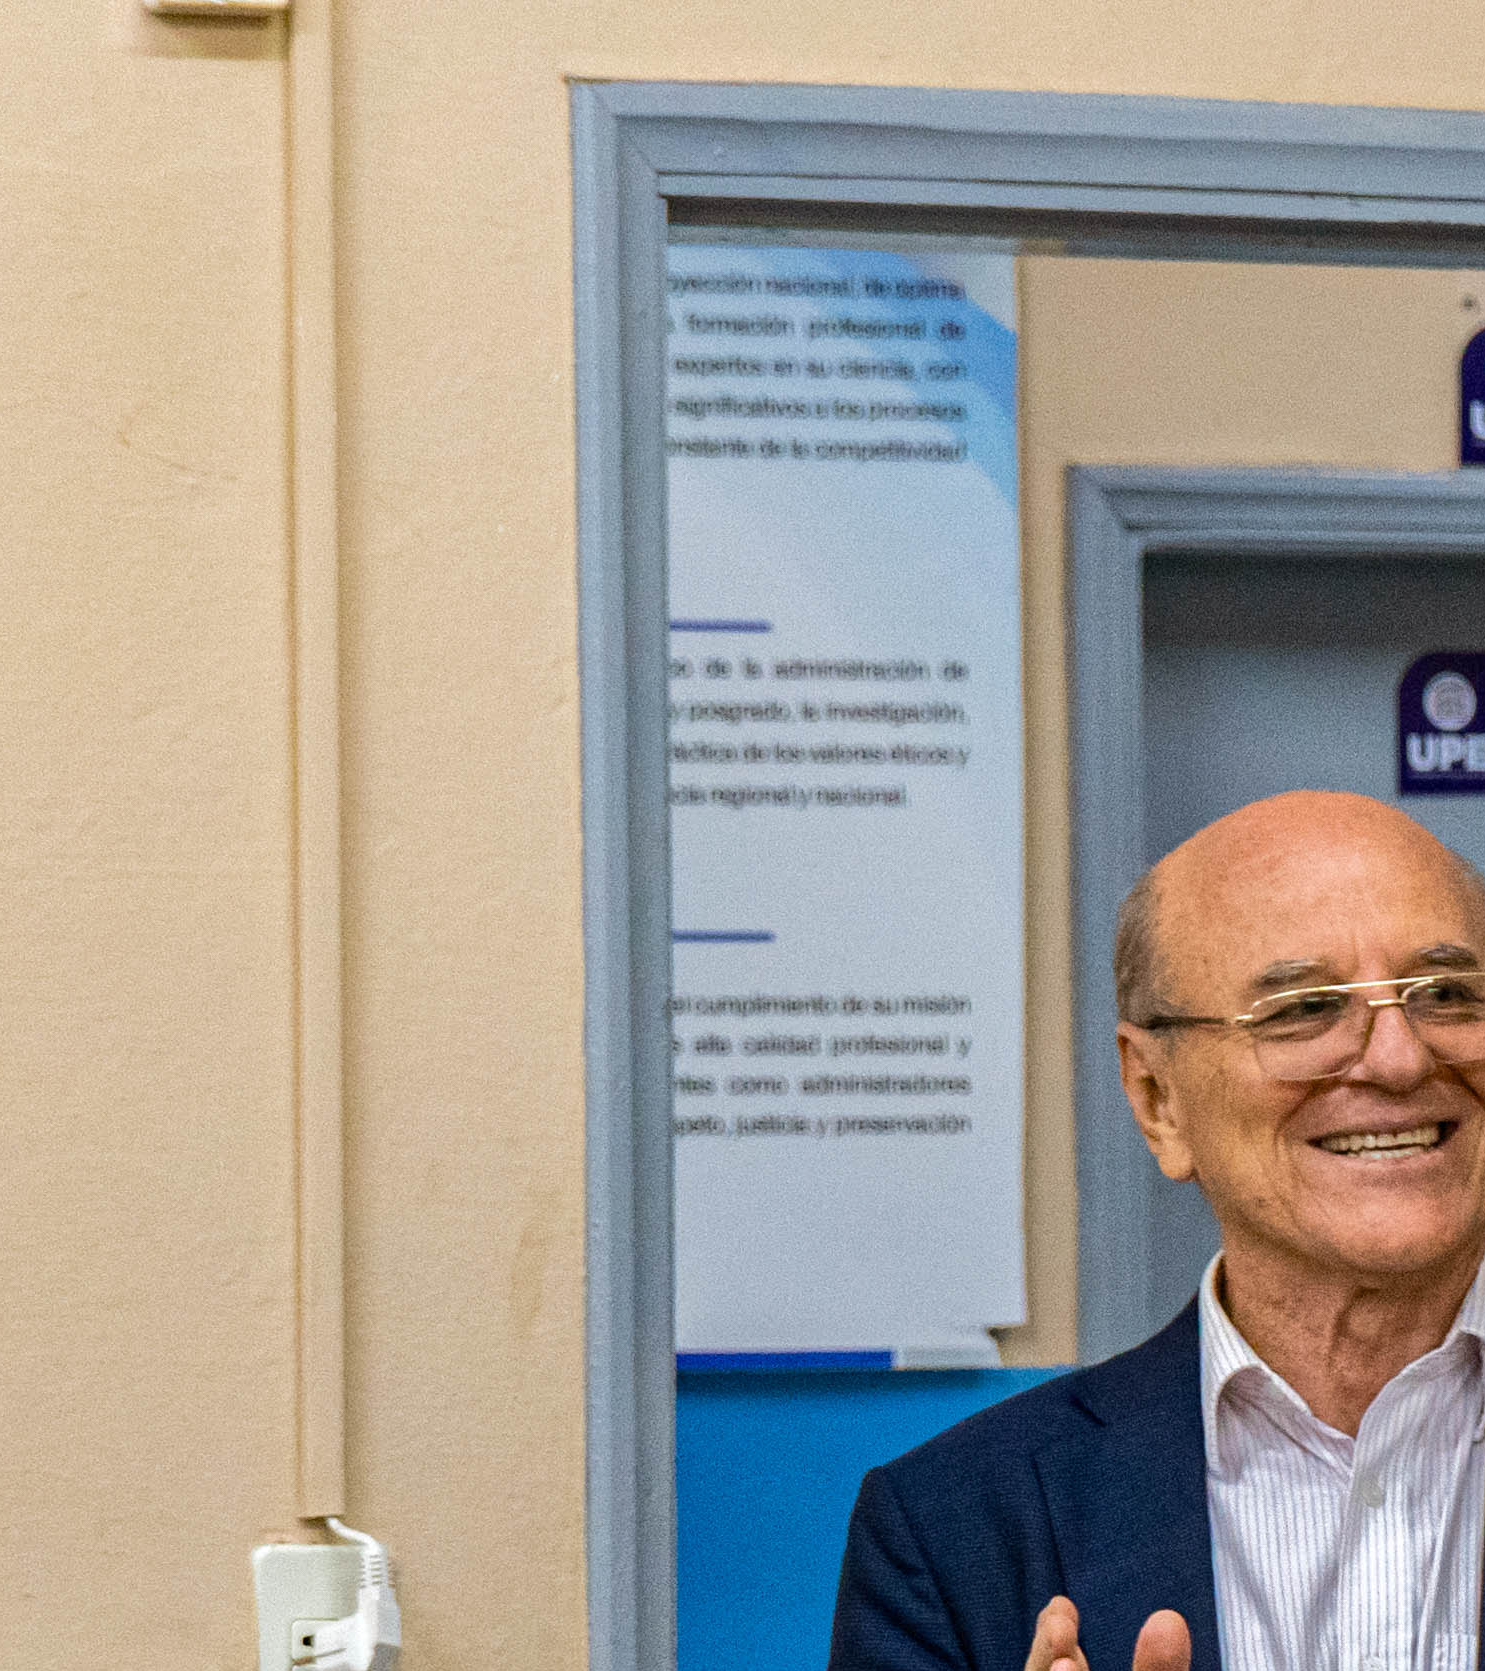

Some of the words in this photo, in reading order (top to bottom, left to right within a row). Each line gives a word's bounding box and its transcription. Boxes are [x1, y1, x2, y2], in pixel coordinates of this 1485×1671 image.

[937, 318, 966, 341] de
[772, 656, 930, 682] administración
[694, 995, 837, 1019] cumplimiento
[840, 996, 868, 1016] de
[872, 997, 899, 1017] su
[901, 995, 972, 1017] misión
[692, 1033, 733, 1057] alta
[741, 1032, 822, 1057] calidad
[828, 1033, 949, 1059] profesional
[726, 1075, 789, 1097] como
[798, 1072, 973, 1097] administradores
[736, 1113, 811, 1139] justicia
[832, 1113, 972, 1139] preservación
